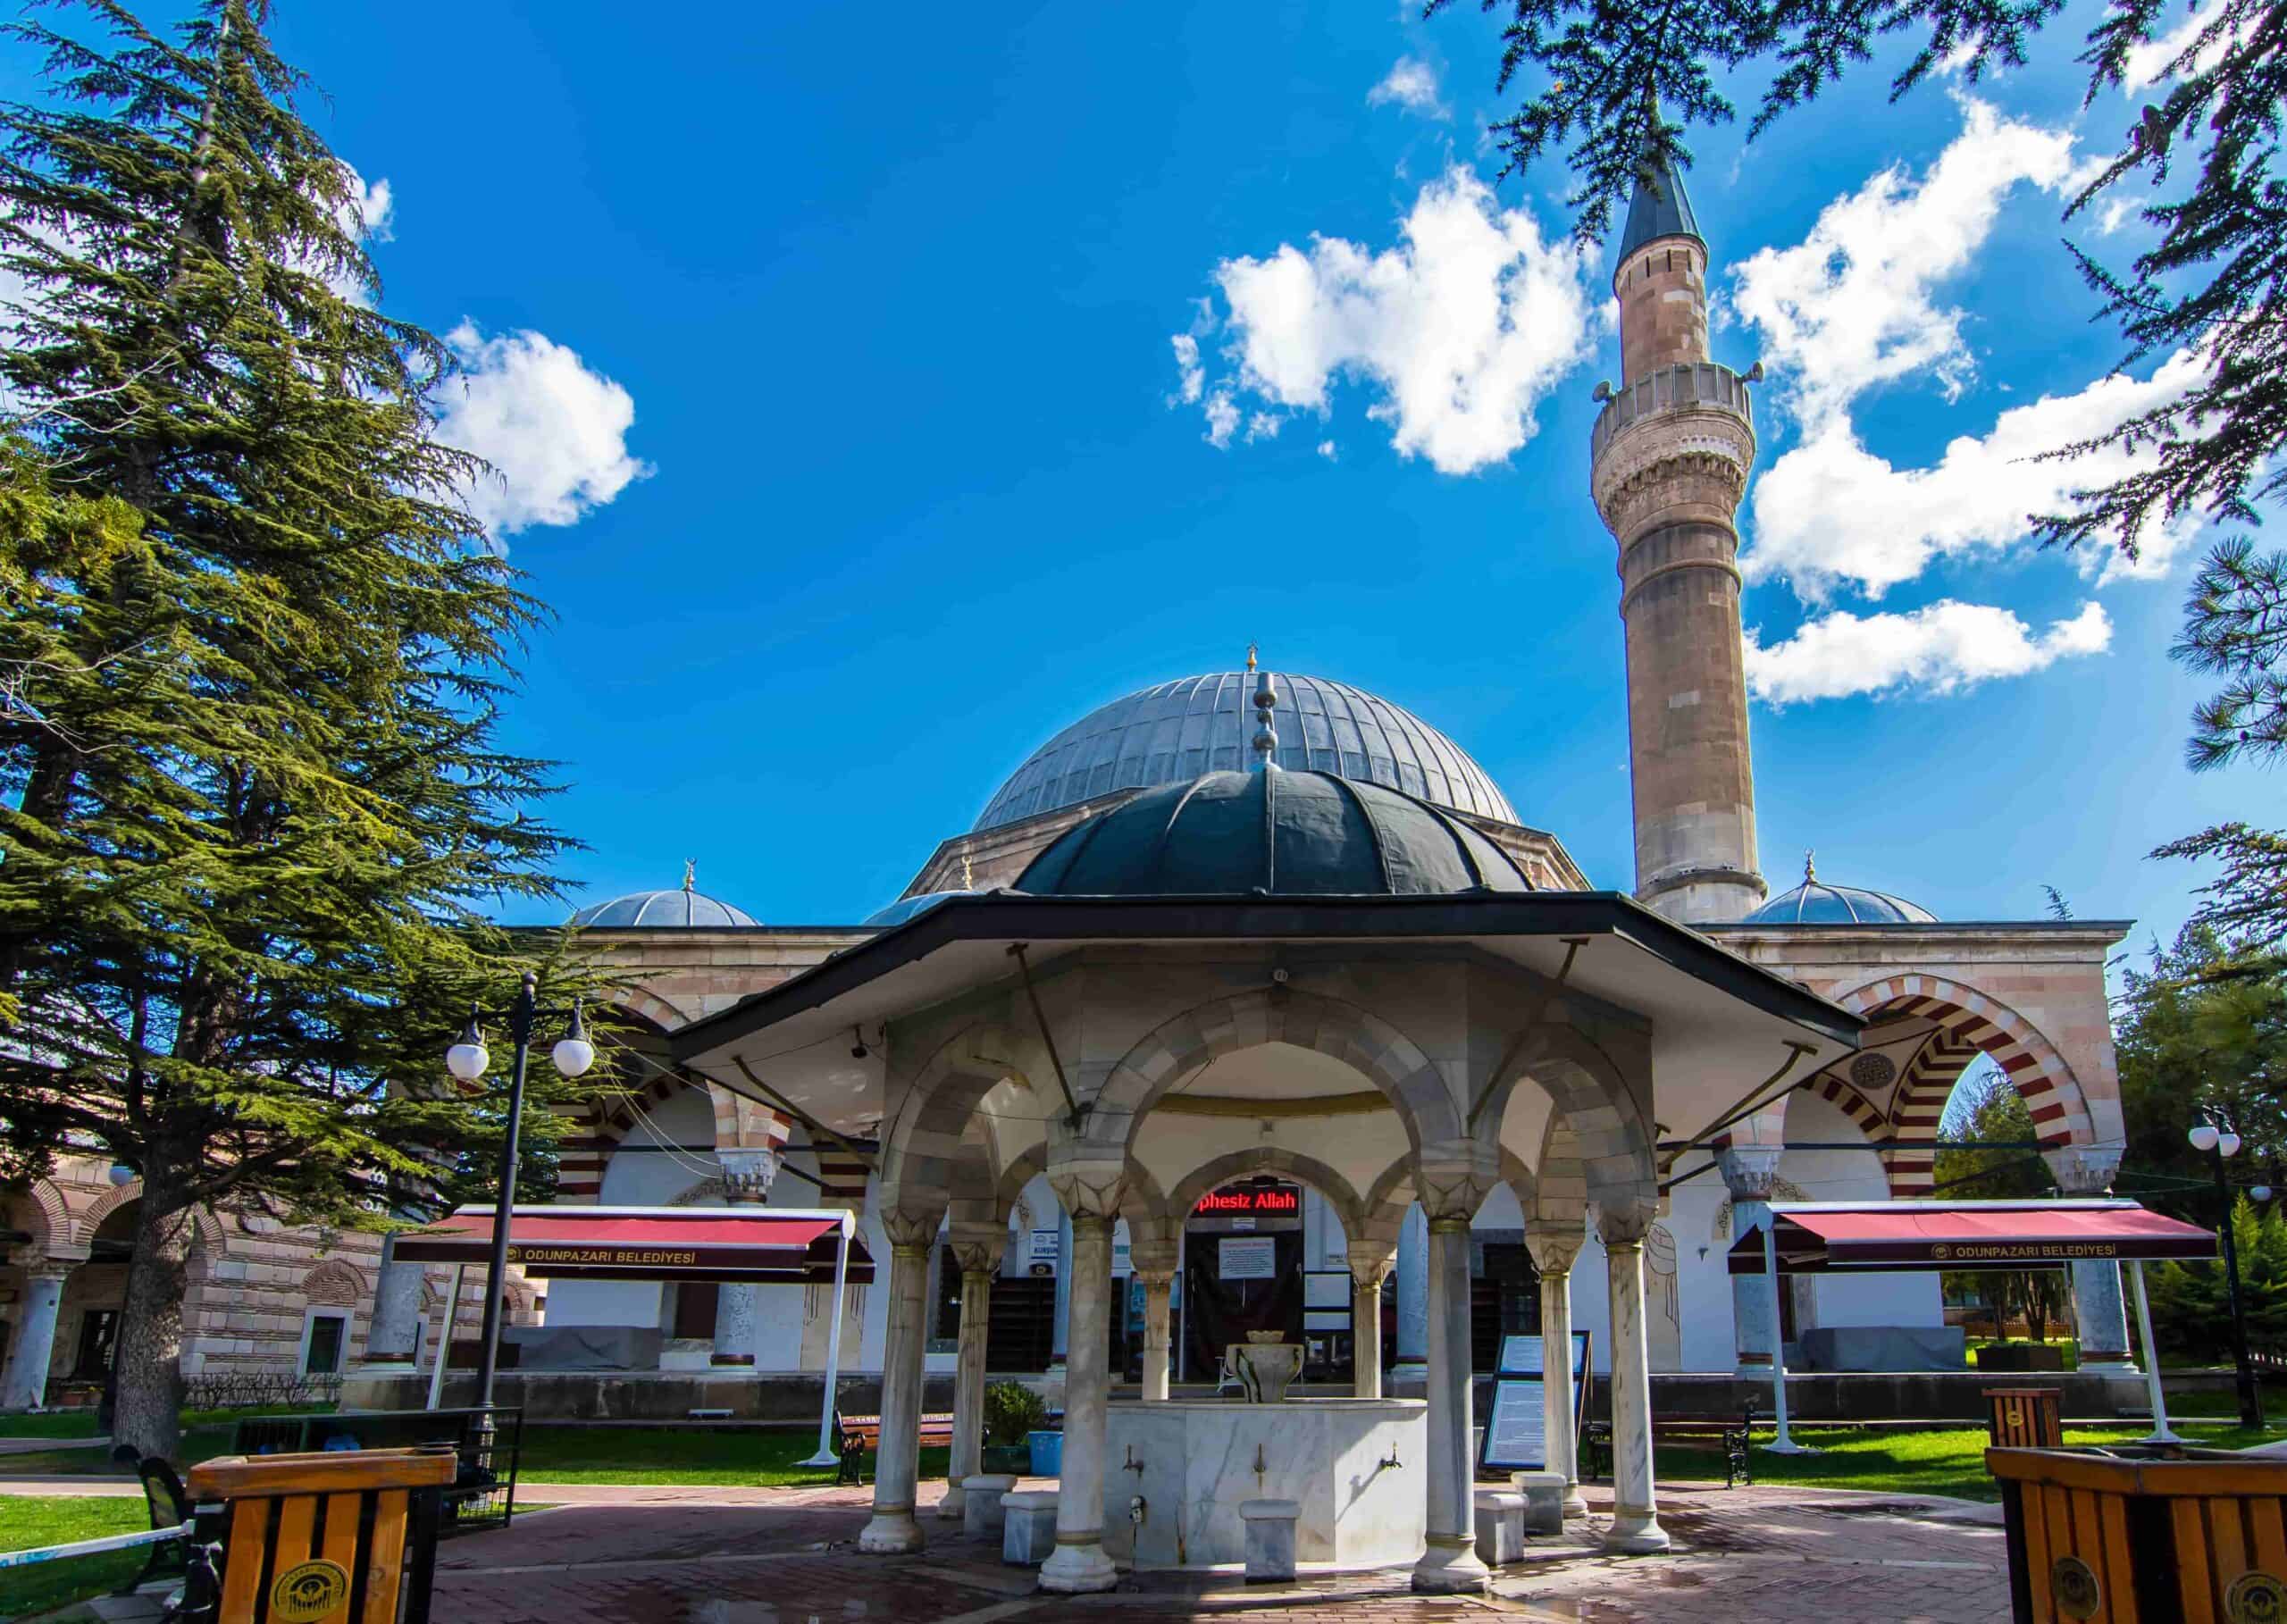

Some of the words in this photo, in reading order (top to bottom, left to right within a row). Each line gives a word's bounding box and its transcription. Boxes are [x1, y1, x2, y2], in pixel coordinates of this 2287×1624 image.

[1255, 1193, 1295, 1209] Allah
[525, 1250, 611, 1262] ODUNPAZARI
[616, 1251, 695, 1264] BELEDİYESİ
[1956, 1245, 2039, 1258] ODUNPAZARI
[2043, 1243, 2116, 1257] BELEDİYESİ
